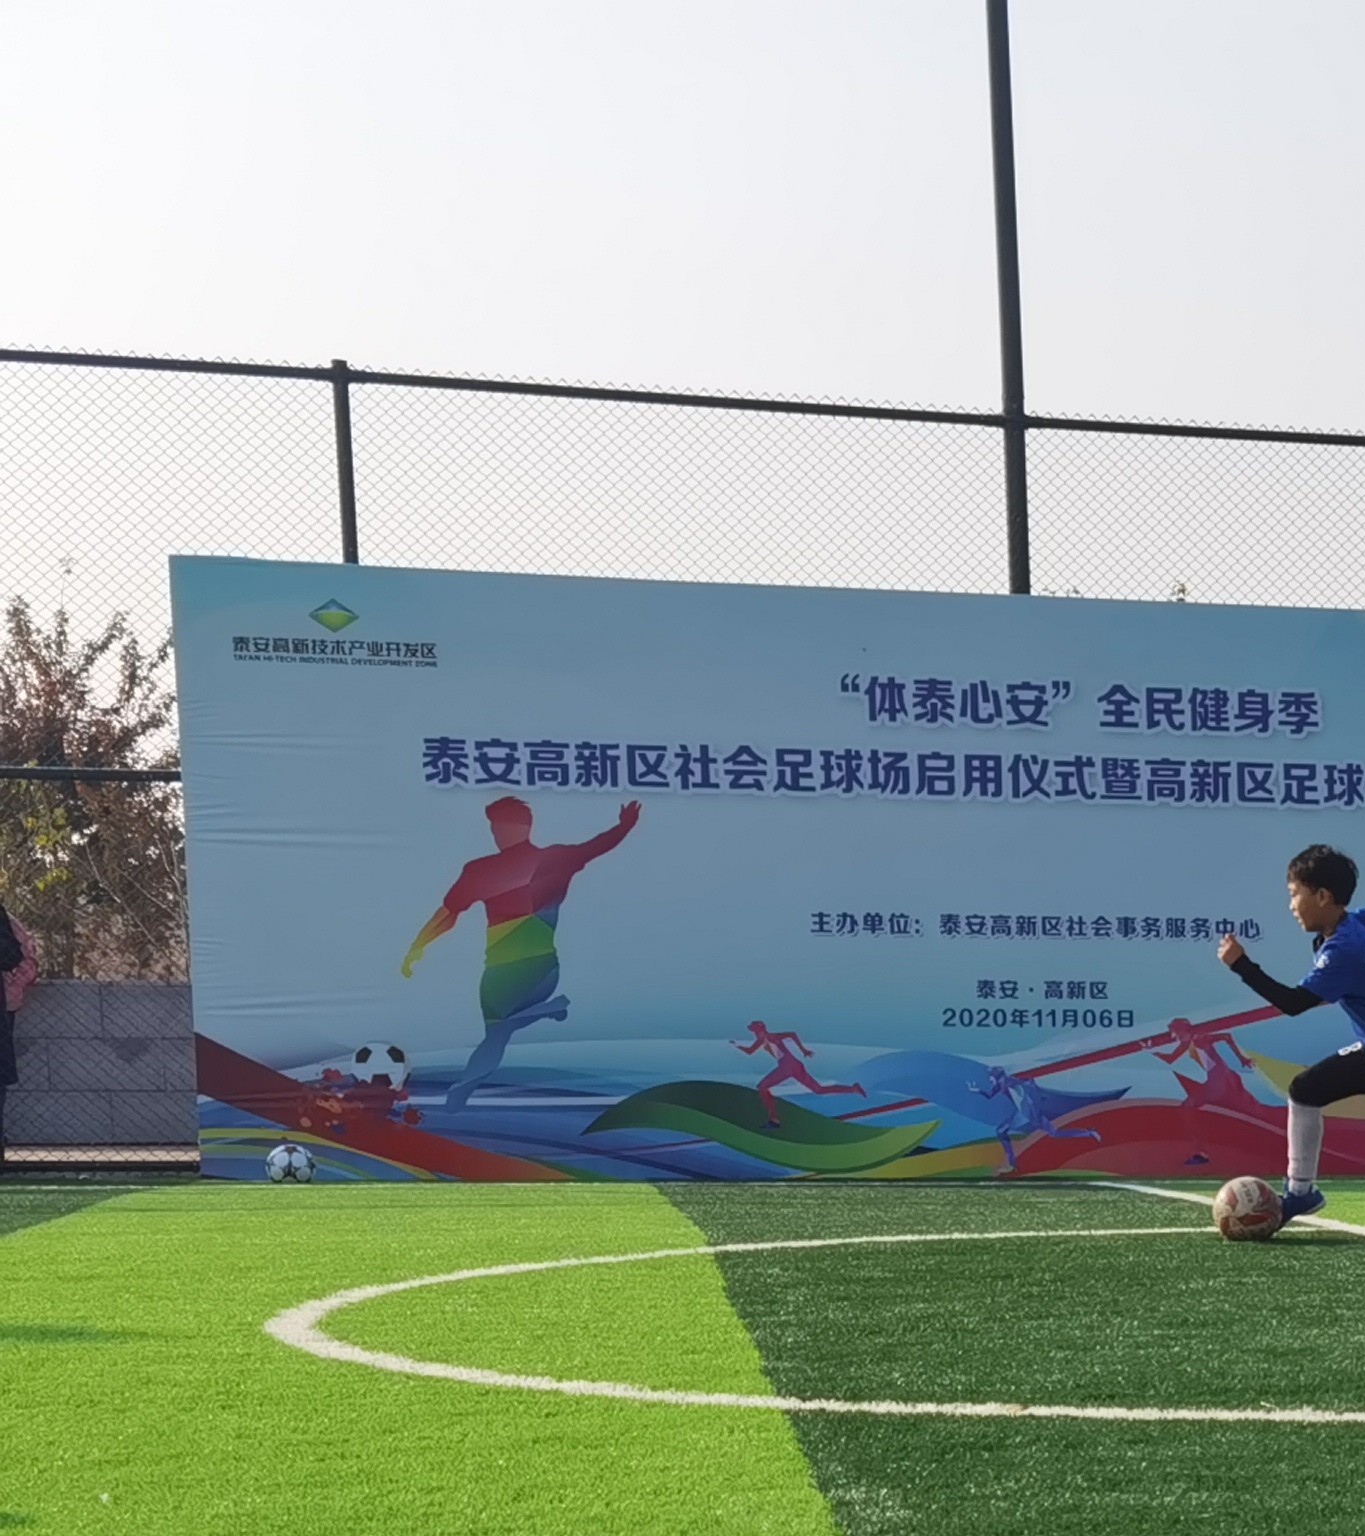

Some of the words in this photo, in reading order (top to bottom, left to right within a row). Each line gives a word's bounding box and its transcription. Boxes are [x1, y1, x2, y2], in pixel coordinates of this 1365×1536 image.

[232, 636, 437, 659] 泰安高新技术产业开发区
[942, 1008, 1135, 1029] 2020年11月06日
